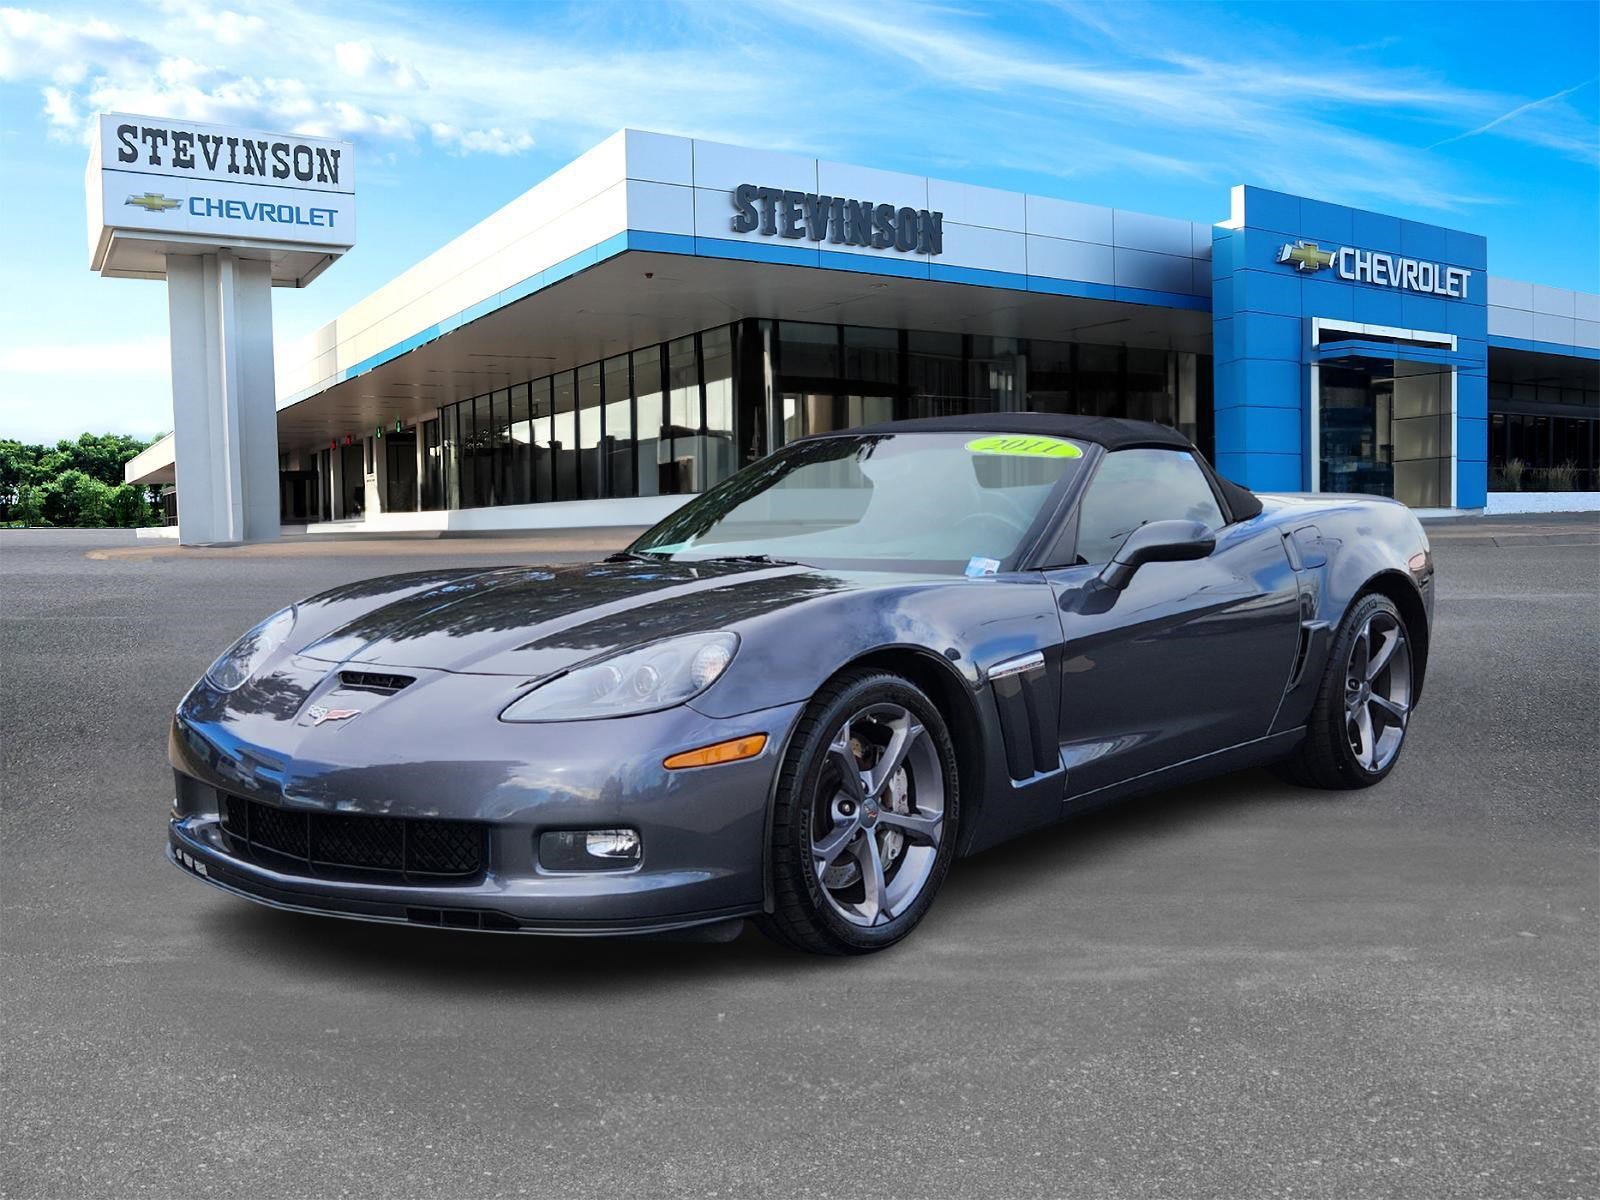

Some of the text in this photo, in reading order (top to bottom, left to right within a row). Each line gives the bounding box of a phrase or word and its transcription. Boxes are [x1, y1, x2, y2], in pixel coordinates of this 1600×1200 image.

[117, 124, 340, 184] STEVINSON
[188, 196, 338, 227] CHEVROLET
[731, 184, 943, 255] STEVINSON
[1339, 246, 1471, 298] CHEVROLET
